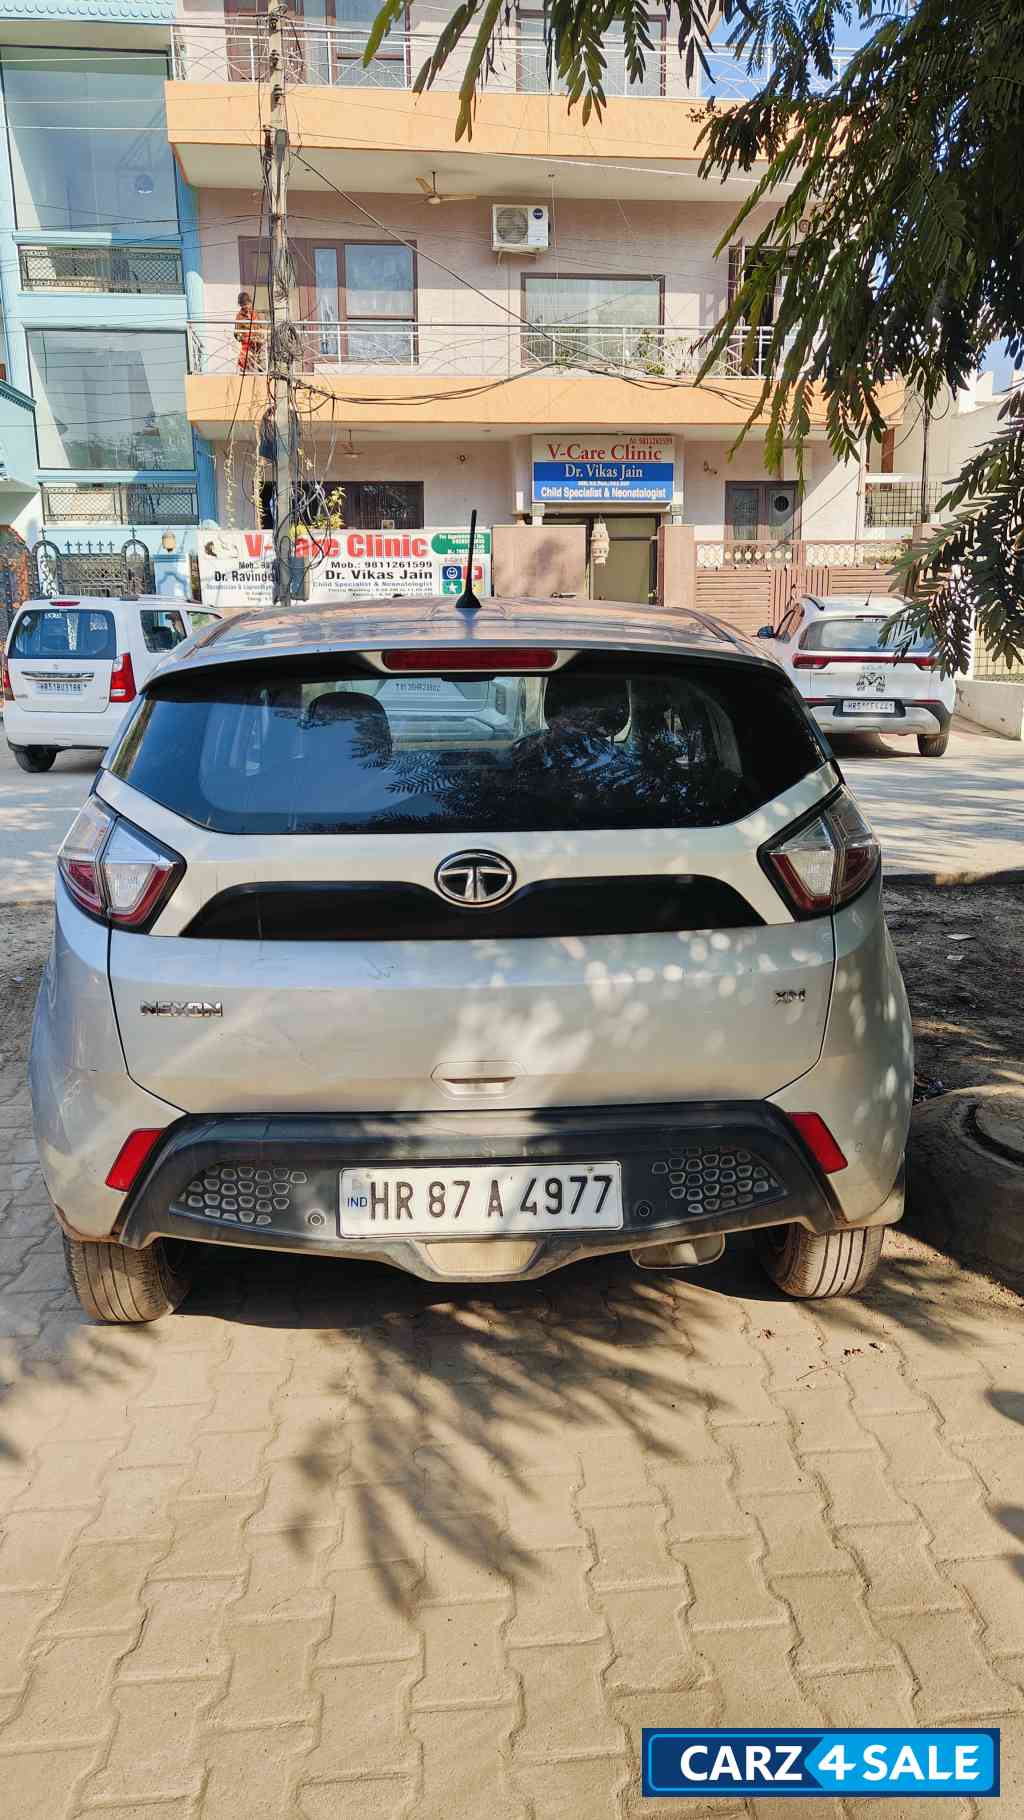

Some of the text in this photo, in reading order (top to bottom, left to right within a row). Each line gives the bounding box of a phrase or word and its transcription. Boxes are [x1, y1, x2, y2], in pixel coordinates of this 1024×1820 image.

[546, 443, 662, 461] V-Care Clinic
[565, 463, 643, 480] Dr. Vikas Jain
[540, 487, 666, 500] Child Specialist & Neonatologist
[347, 534, 428, 558] Clinic
[364, 561, 433, 569] 9811261599
[215, 571, 228, 582] Dr.
[325, 570, 433, 580] Dr. Vikas Jain
[140, 1000, 223, 1017] NEXON
[347, 1196, 368, 1208] IND
[370, 1174, 614, 1219] HR 87 A 4977
